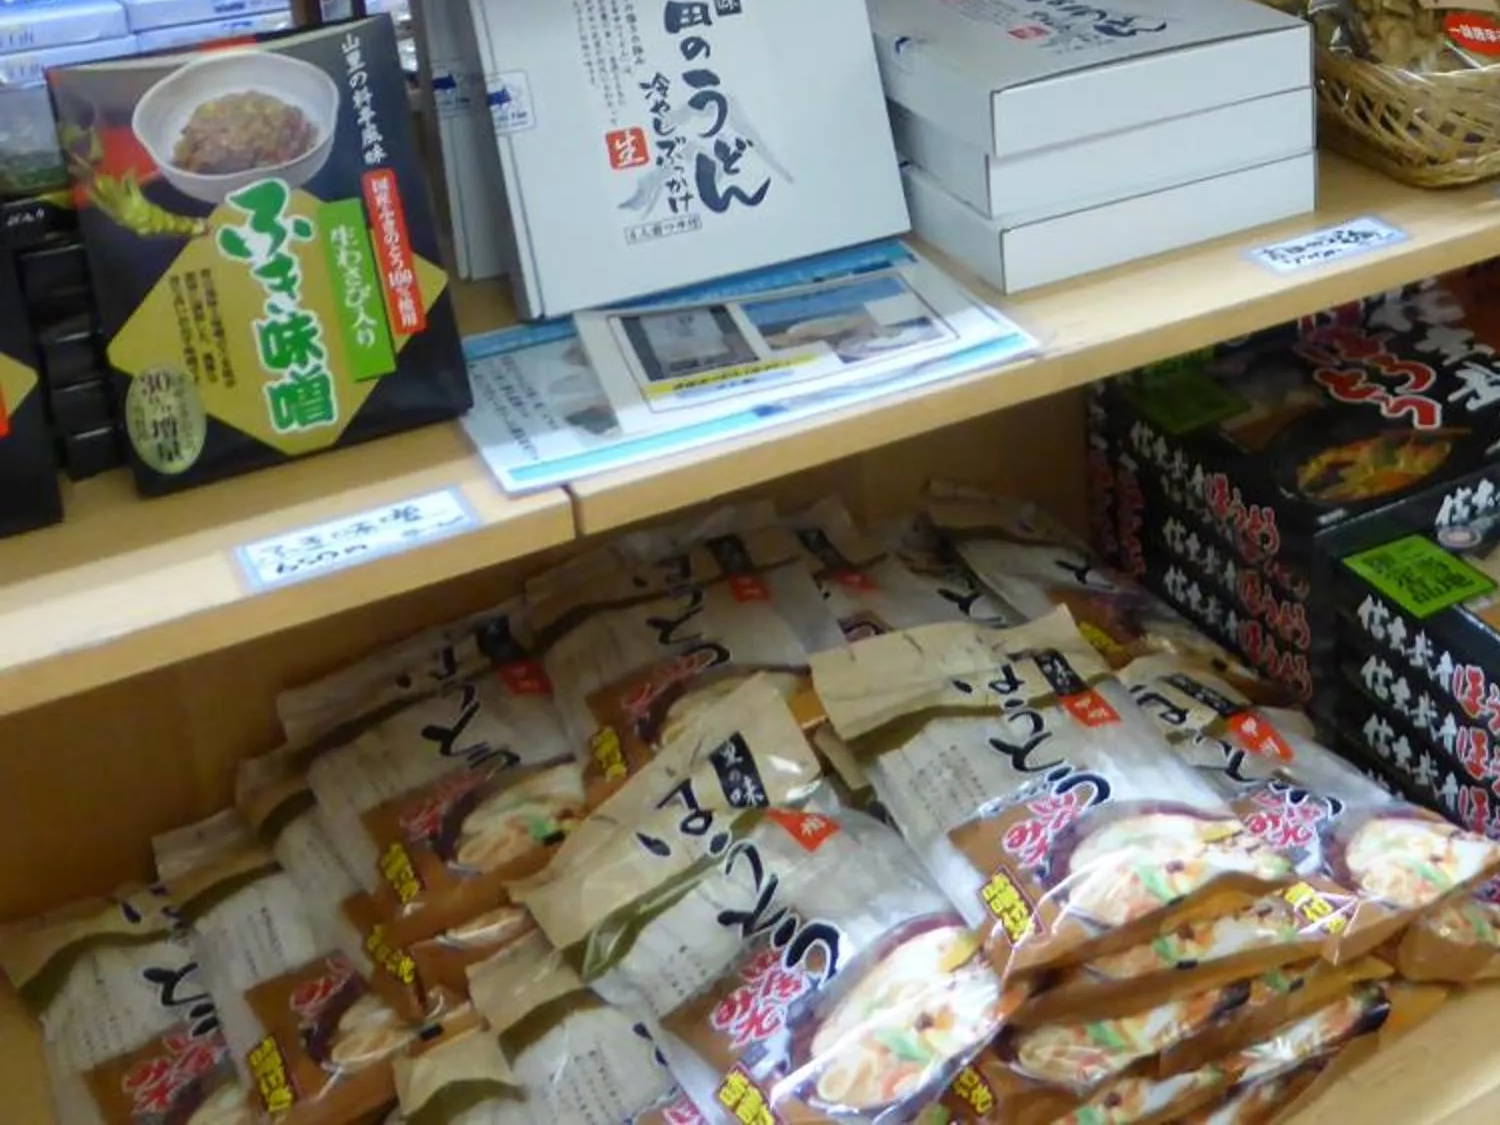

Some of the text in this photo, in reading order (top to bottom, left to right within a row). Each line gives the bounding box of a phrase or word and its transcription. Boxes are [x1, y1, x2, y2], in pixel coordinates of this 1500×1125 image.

[613, 129, 646, 166] 生
[219, 179, 337, 432] ふき味噌
